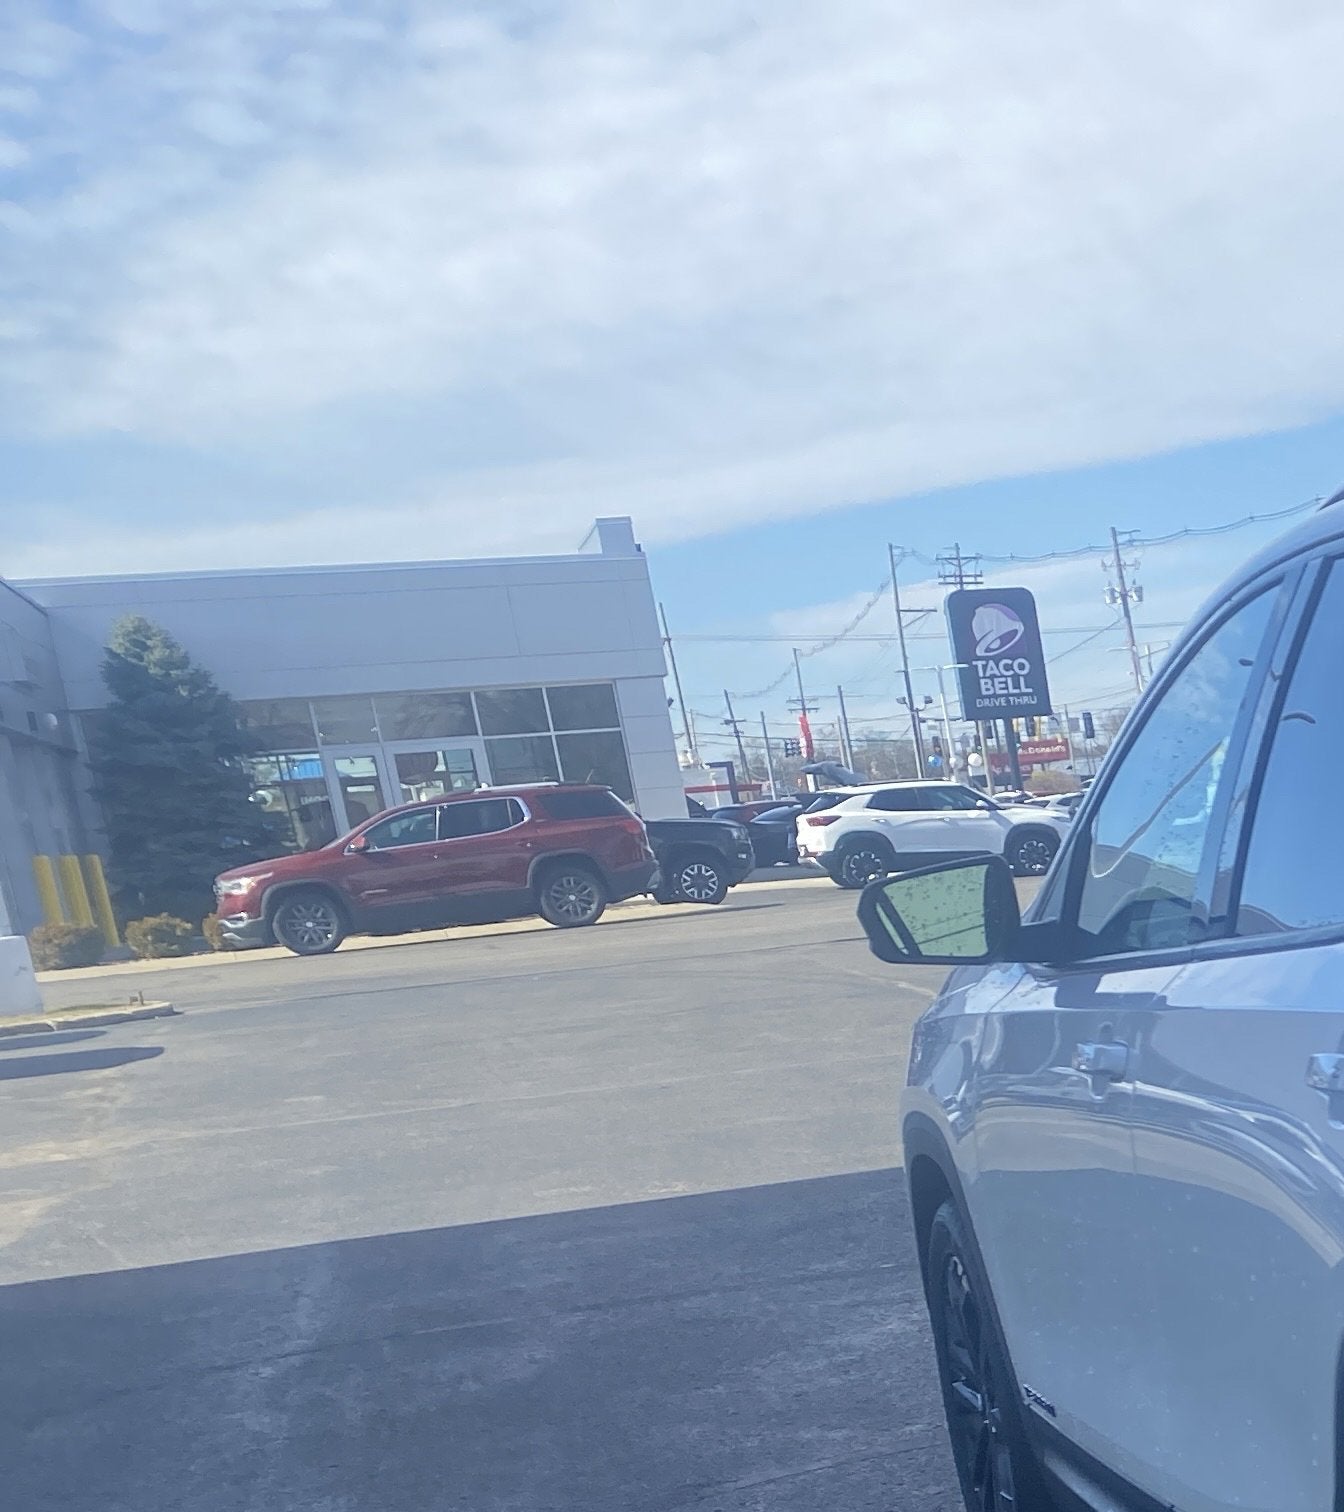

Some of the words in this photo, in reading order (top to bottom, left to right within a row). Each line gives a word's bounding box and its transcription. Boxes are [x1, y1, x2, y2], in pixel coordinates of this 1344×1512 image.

[972, 657, 1031, 678] TACO
[979, 674, 1033, 696] BELL
[976, 697, 1008, 708] DRIVE
[1008, 695, 1038, 706] THRU
